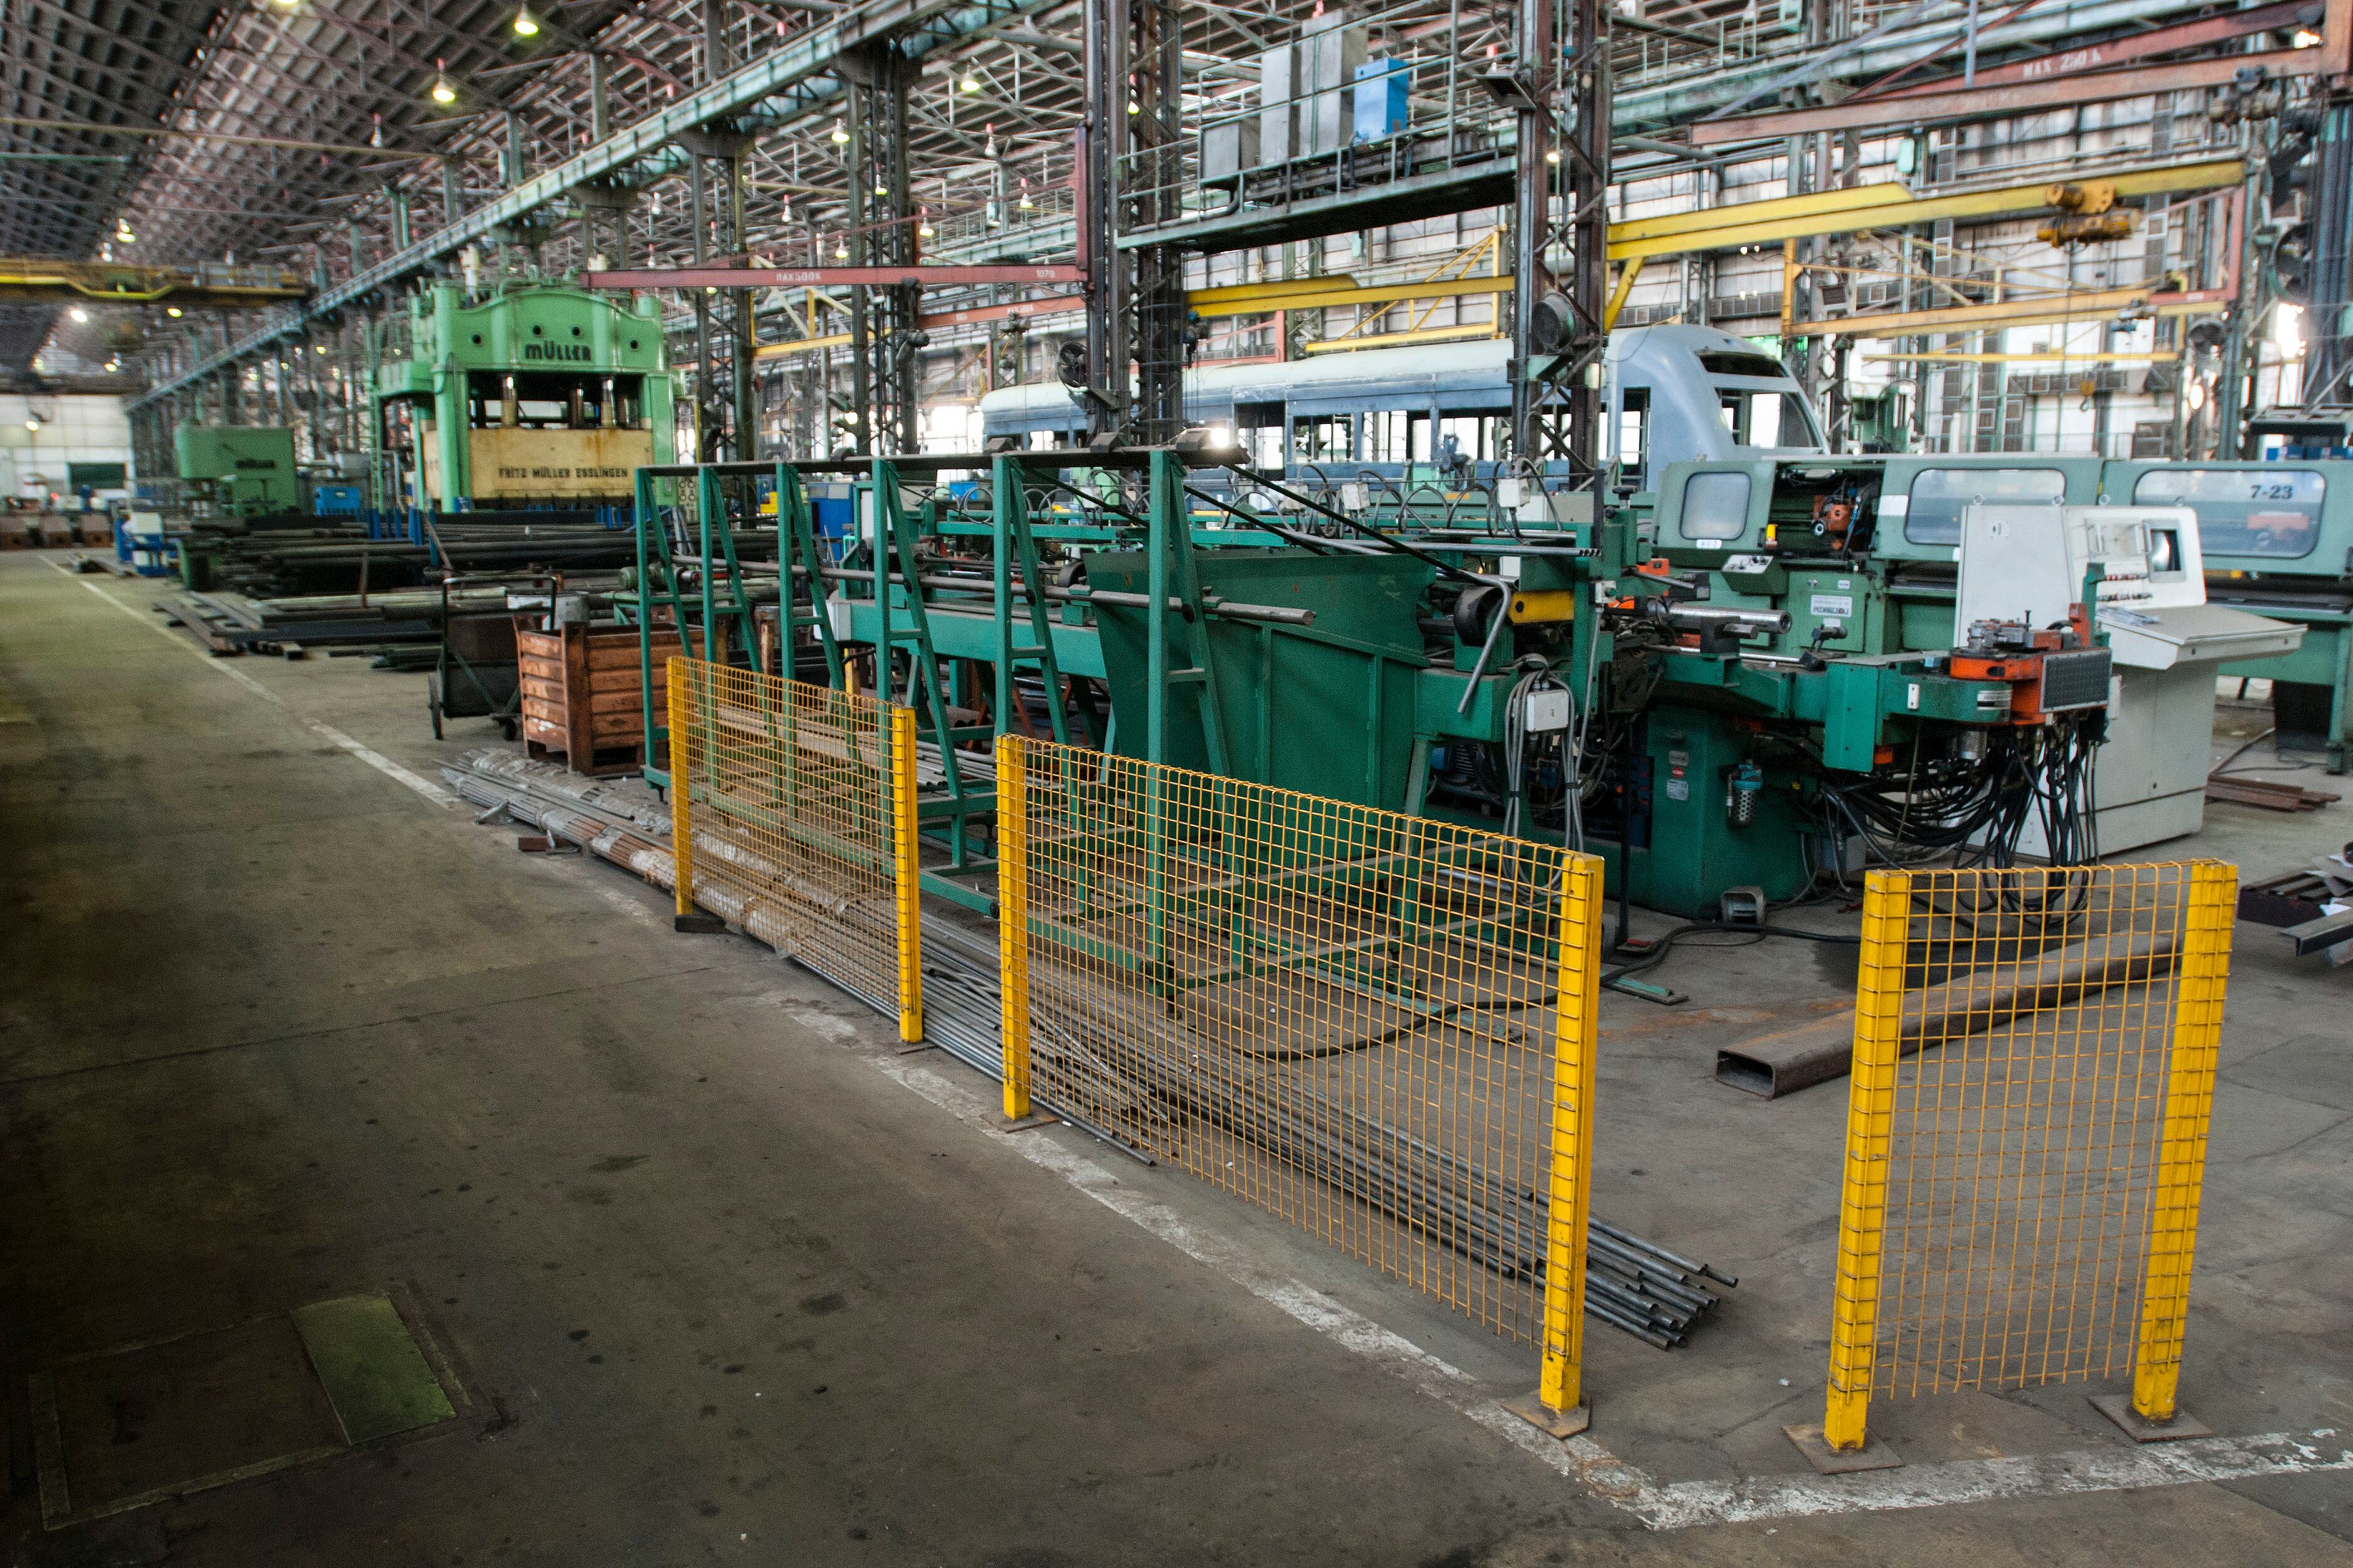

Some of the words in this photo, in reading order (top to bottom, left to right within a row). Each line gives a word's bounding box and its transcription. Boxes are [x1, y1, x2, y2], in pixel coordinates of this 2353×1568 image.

[1036, 270, 1054, 278] 1079
[499, 468, 526, 478] FRITZ
[532, 467, 570, 478] MÜLLER
[575, 468, 627, 477] ESSLINGEN
[2251, 485, 2293, 499] 7-23
